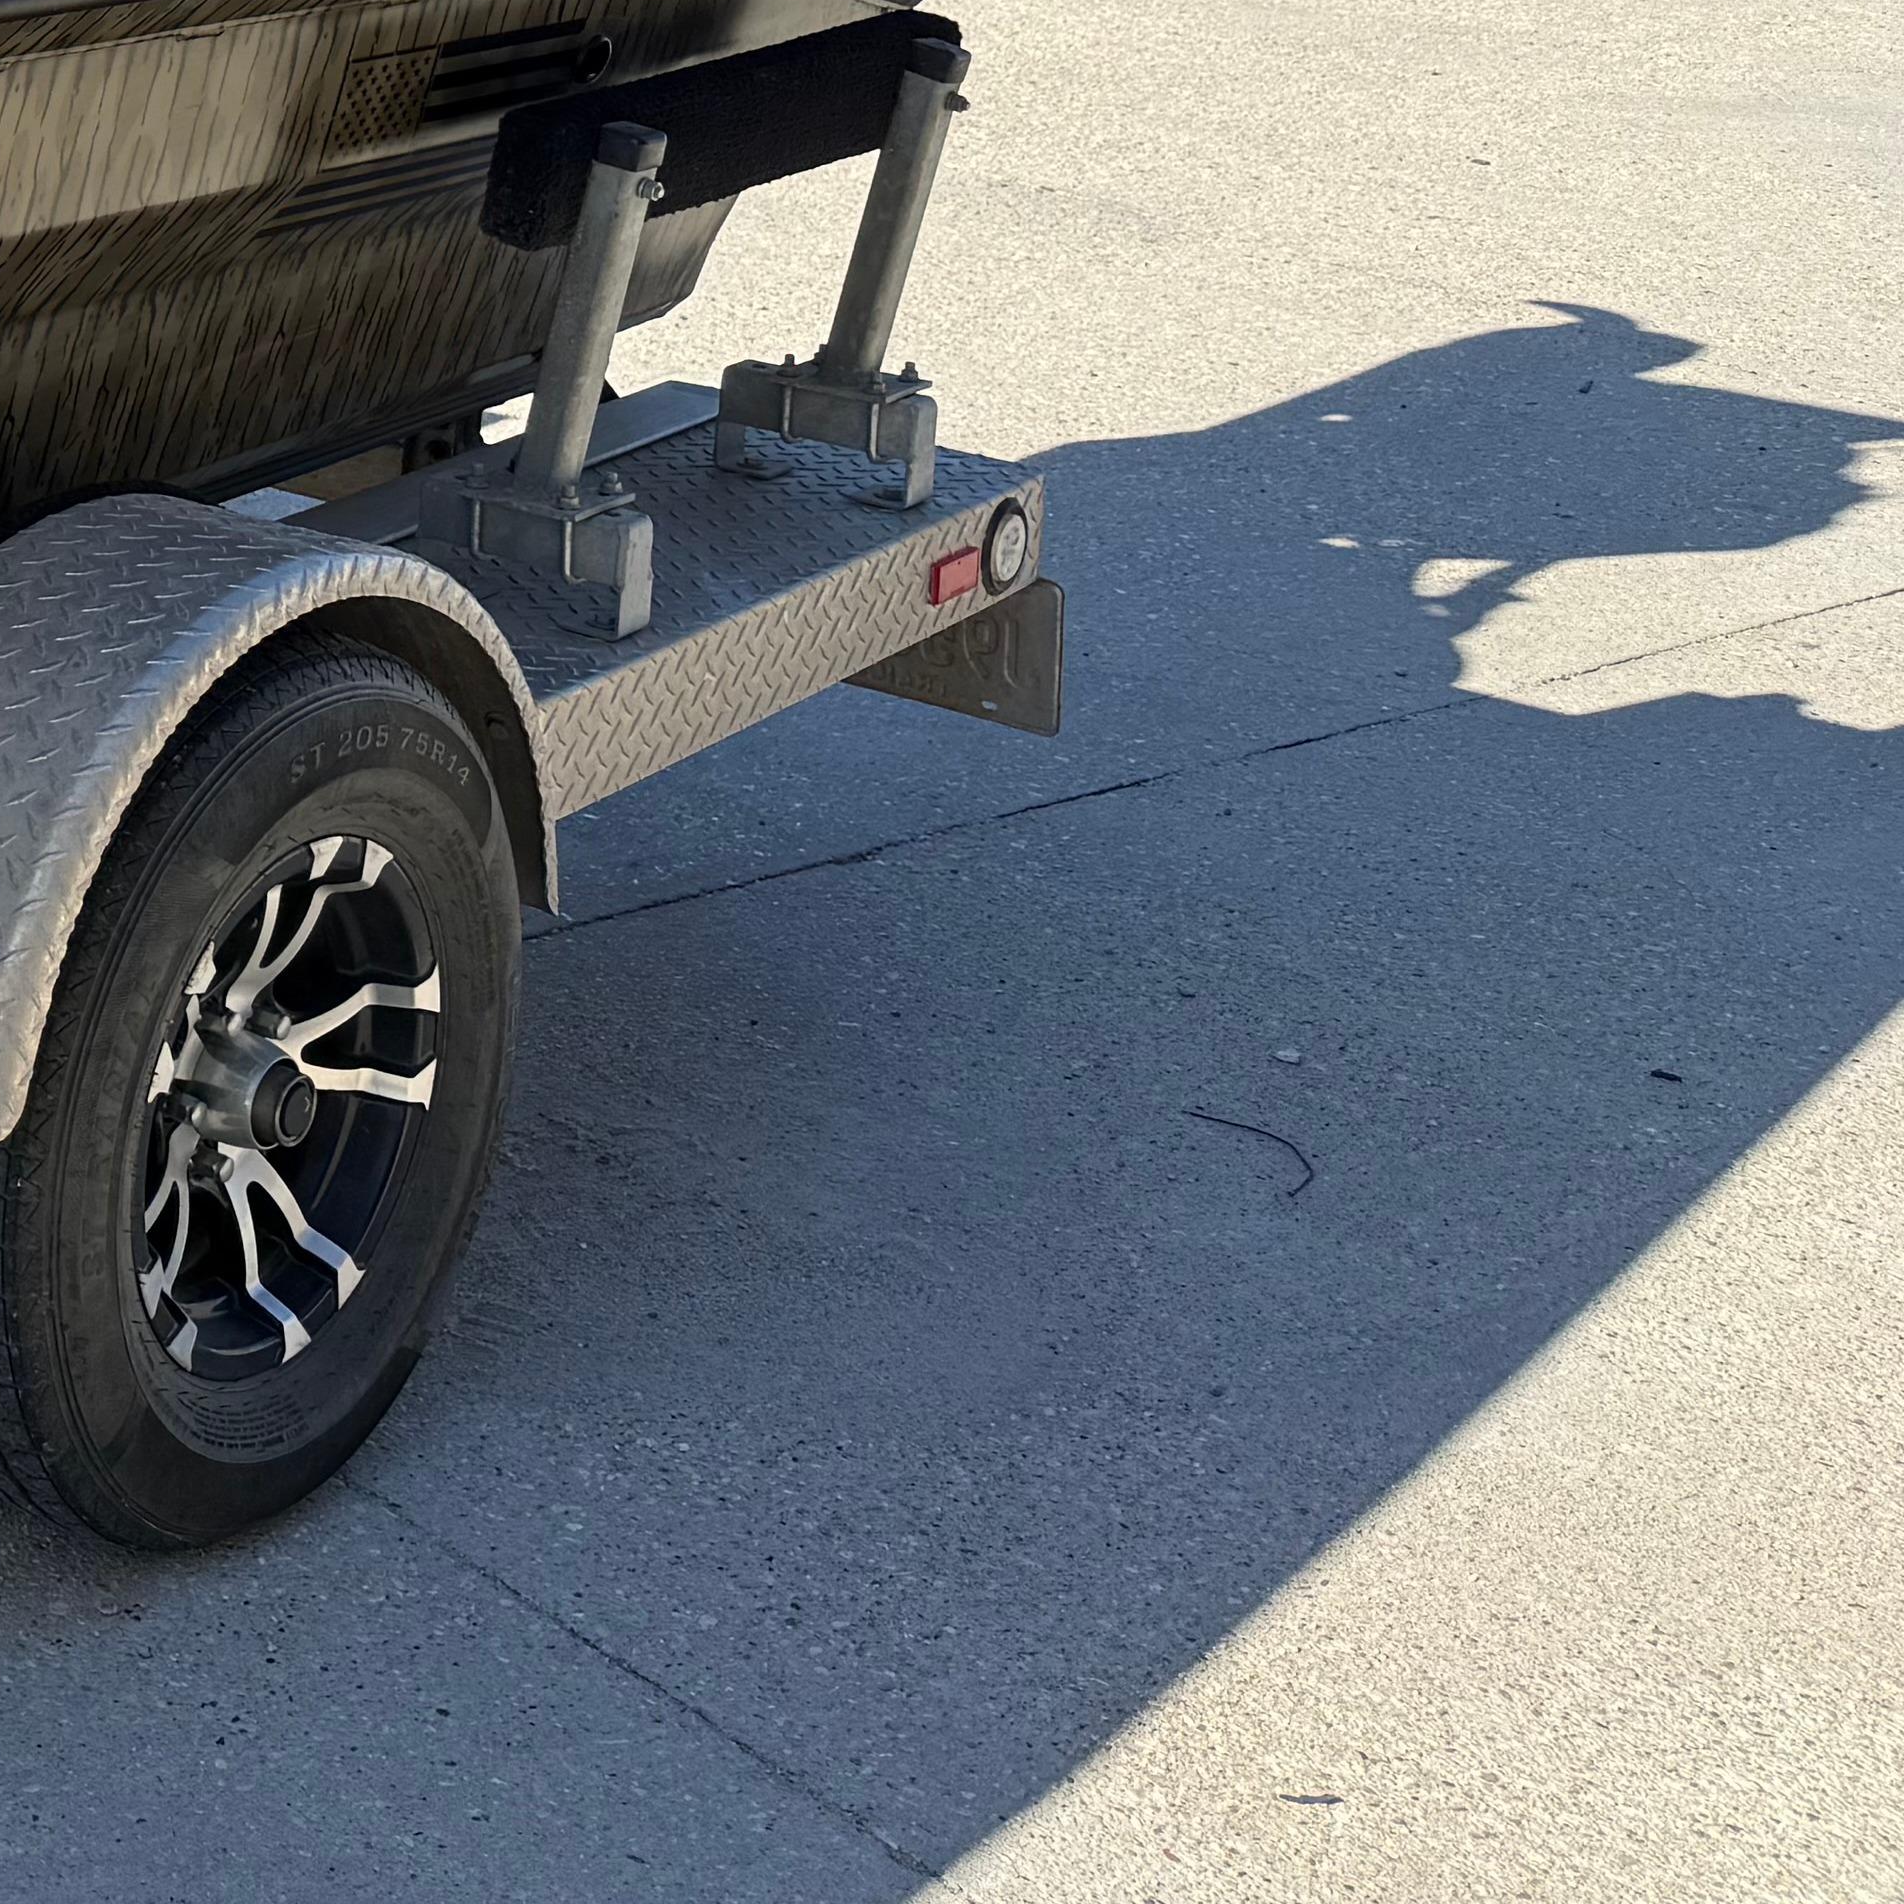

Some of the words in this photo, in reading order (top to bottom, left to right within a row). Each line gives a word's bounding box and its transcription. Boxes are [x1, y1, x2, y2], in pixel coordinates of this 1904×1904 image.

[290, 741, 325, 783] ST
[338, 725, 389, 758] 205
[400, 727, 471, 787] 75R14
